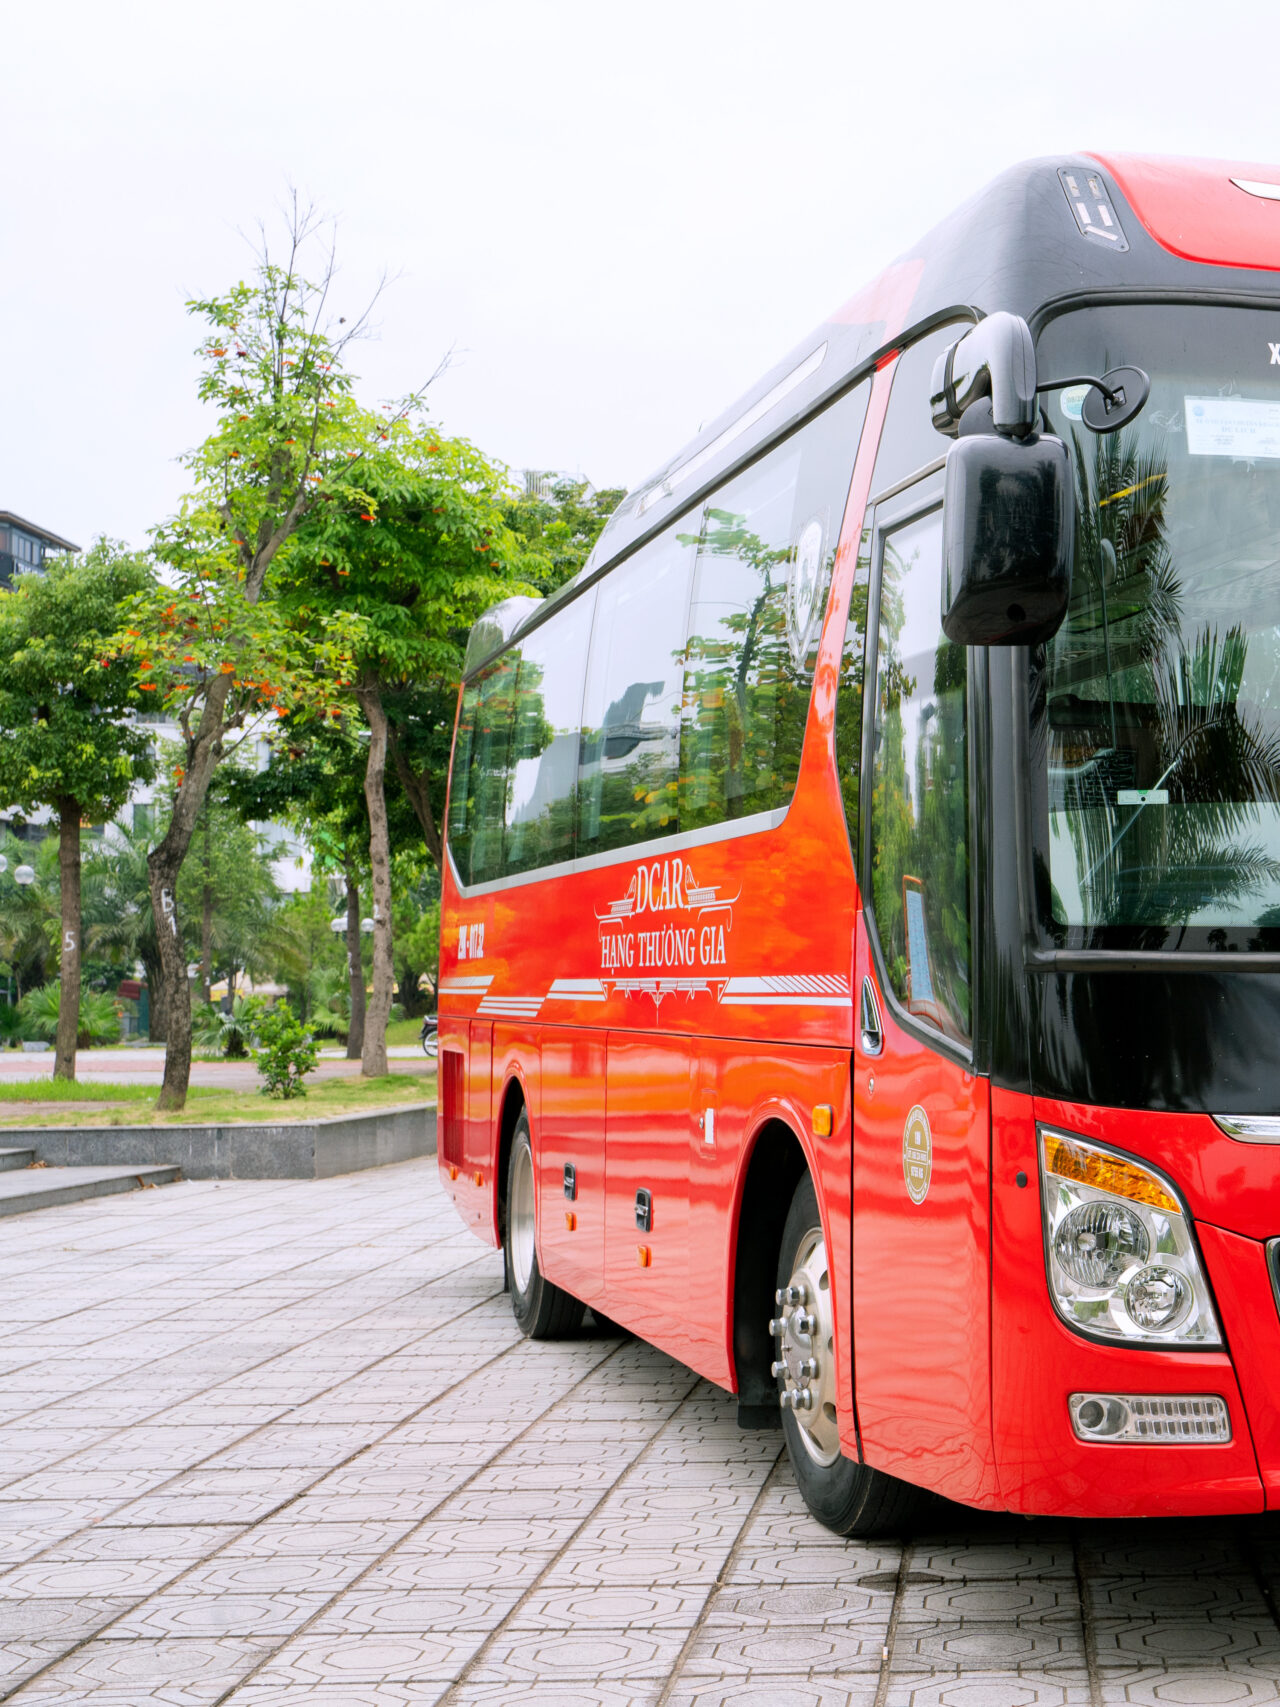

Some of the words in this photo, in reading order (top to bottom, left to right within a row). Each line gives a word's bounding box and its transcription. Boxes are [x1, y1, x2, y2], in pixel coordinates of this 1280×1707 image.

[636, 858, 684, 914] DCAR
[64, 931, 76, 952] 5
[601, 933, 635, 975] HẠNG
[638, 922, 696, 967] THƯƠNG
[699, 924, 727, 966] GIA
